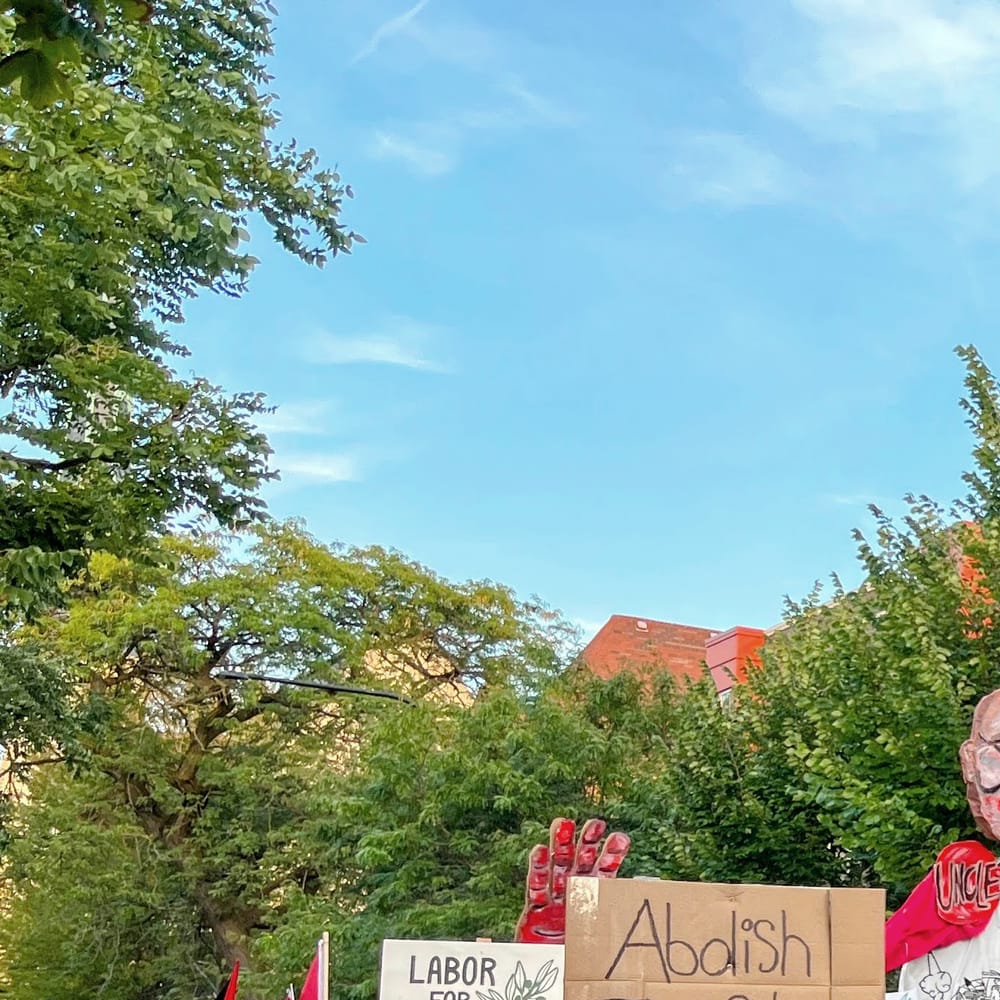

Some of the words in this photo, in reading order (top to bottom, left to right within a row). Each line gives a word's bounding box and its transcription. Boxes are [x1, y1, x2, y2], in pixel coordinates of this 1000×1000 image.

[935, 861, 999, 911] UNCLE
[604, 898, 812, 984] Abolish
[409, 955, 497, 986] LABOR
